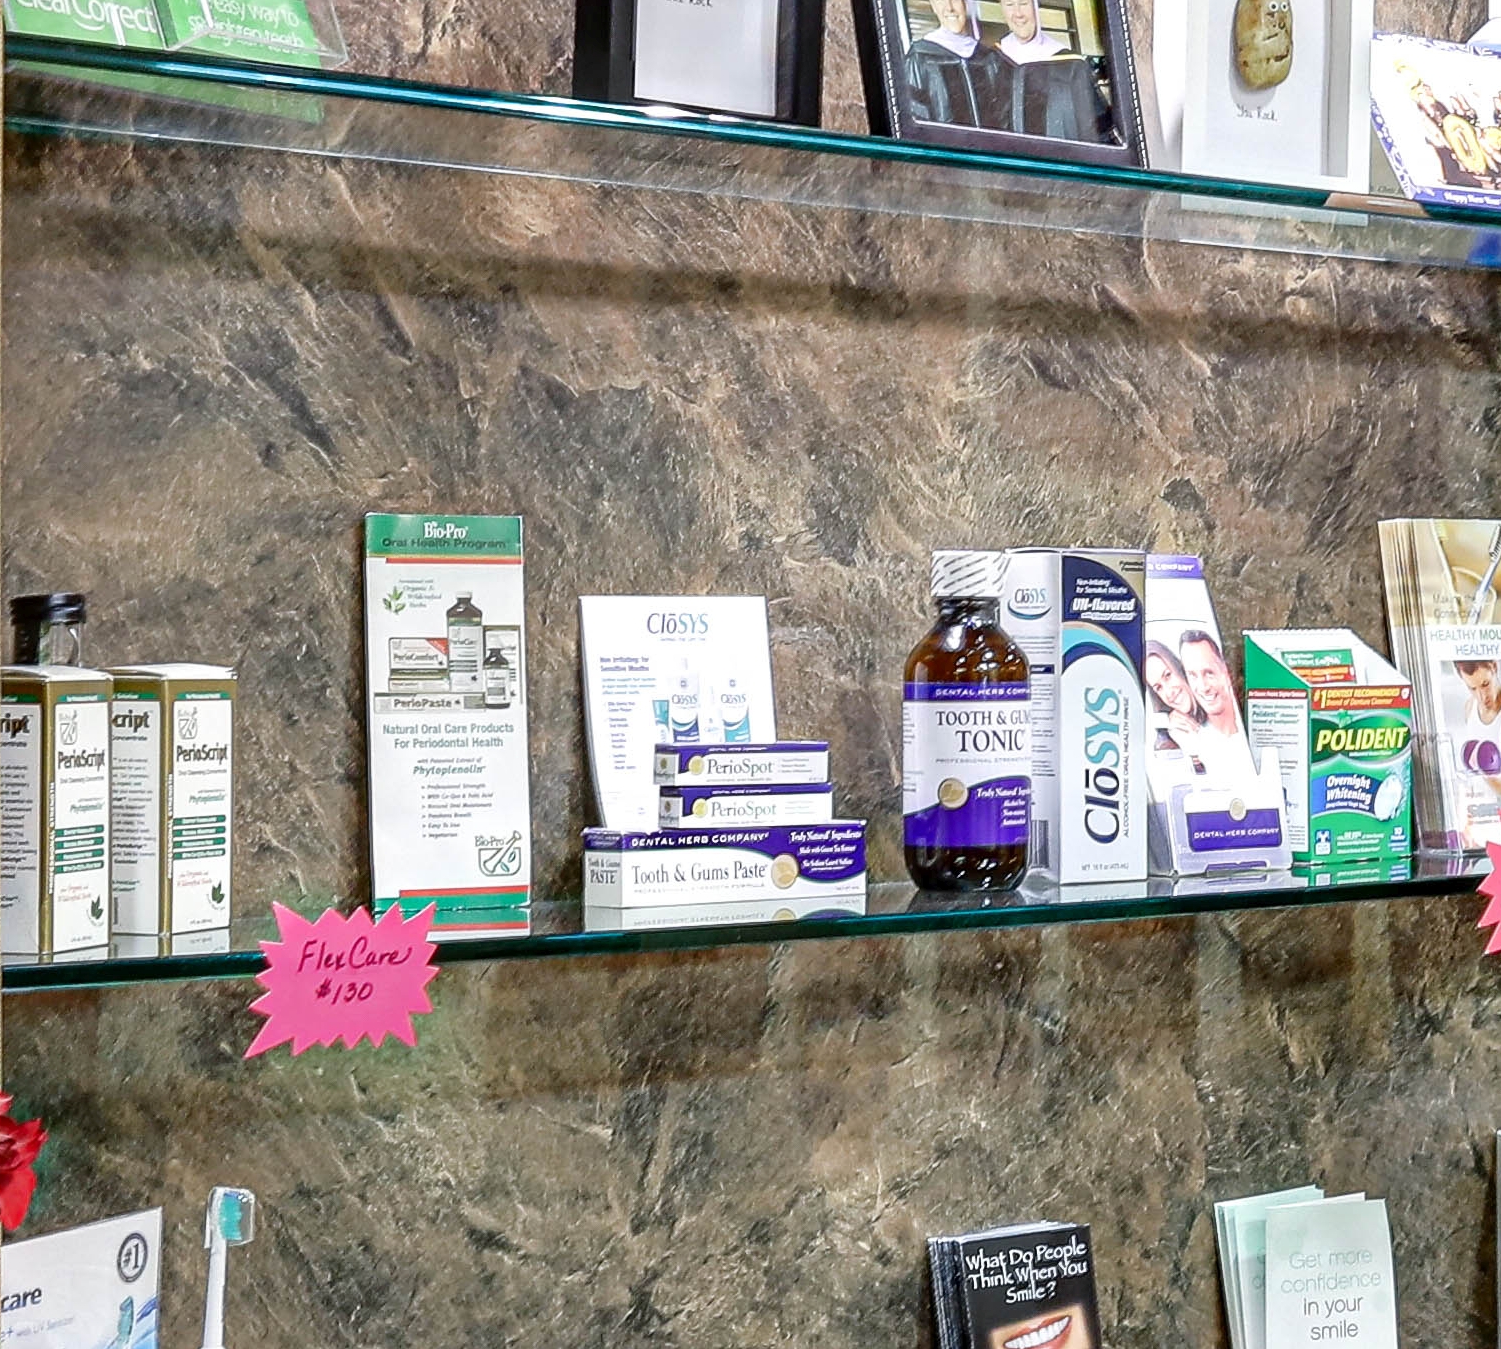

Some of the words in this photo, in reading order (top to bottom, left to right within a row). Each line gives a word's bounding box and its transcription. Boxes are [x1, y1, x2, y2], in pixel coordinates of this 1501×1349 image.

[382, 538, 407, 548] Oral
[411, 538, 449, 548] Health
[453, 539, 506, 550] Program
[1430, 630, 1476, 641] HEALTHY
[1455, 645, 1499, 656] HEALTHY
[936, 710, 992, 726] TOOTH
[996, 711, 1007, 725] &
[382, 724, 418, 734] Natural
[421, 724, 441, 734] Oral
[444, 724, 467, 734] Care
[470, 723, 514, 733] Products
[394, 738, 410, 749] For
[413, 738, 469, 748] Periodontal
[472, 737, 503, 747] Health
[955, 730, 1025, 752] TONIC
[1317, 727, 1408, 752] POLIDENT
[58, 748, 105, 772] PerioScript
[176, 742, 228, 765] PerioScript
[707, 757, 773, 777] PerioSpot
[1327, 773, 1371, 790] Overnight
[1326, 789, 1372, 805] Whitening
[711, 801, 777, 819] PerioSpot
[631, 837, 674, 846] DENTAL
[678, 835, 708, 845] HERB
[711, 832, 766, 843] COMPANY
[590, 869, 617, 884] PASTE
[631, 863, 669, 885] Tooth
[673, 863, 686, 882] &
[691, 862, 729, 882] Gums
[734, 860, 766, 879] Paste
[966, 1247, 1007, 1271] What
[1009, 1249, 1034, 1266] Do
[1036, 1234, 1087, 1266] People
[1289, 1252, 1322, 1271] Get
[1328, 1248, 1373, 1268] more
[968, 1267, 1014, 1291] Think
[1015, 1266, 1058, 1283] When
[1058, 1260, 1088, 1278] You
[1280, 1271, 1381, 1295] confidence
[1005, 1280, 1057, 1303] Smile?
[1303, 1297, 1320, 1316] in
[1325, 1296, 1363, 1320] your
[1310, 1322, 1359, 1341] smile
